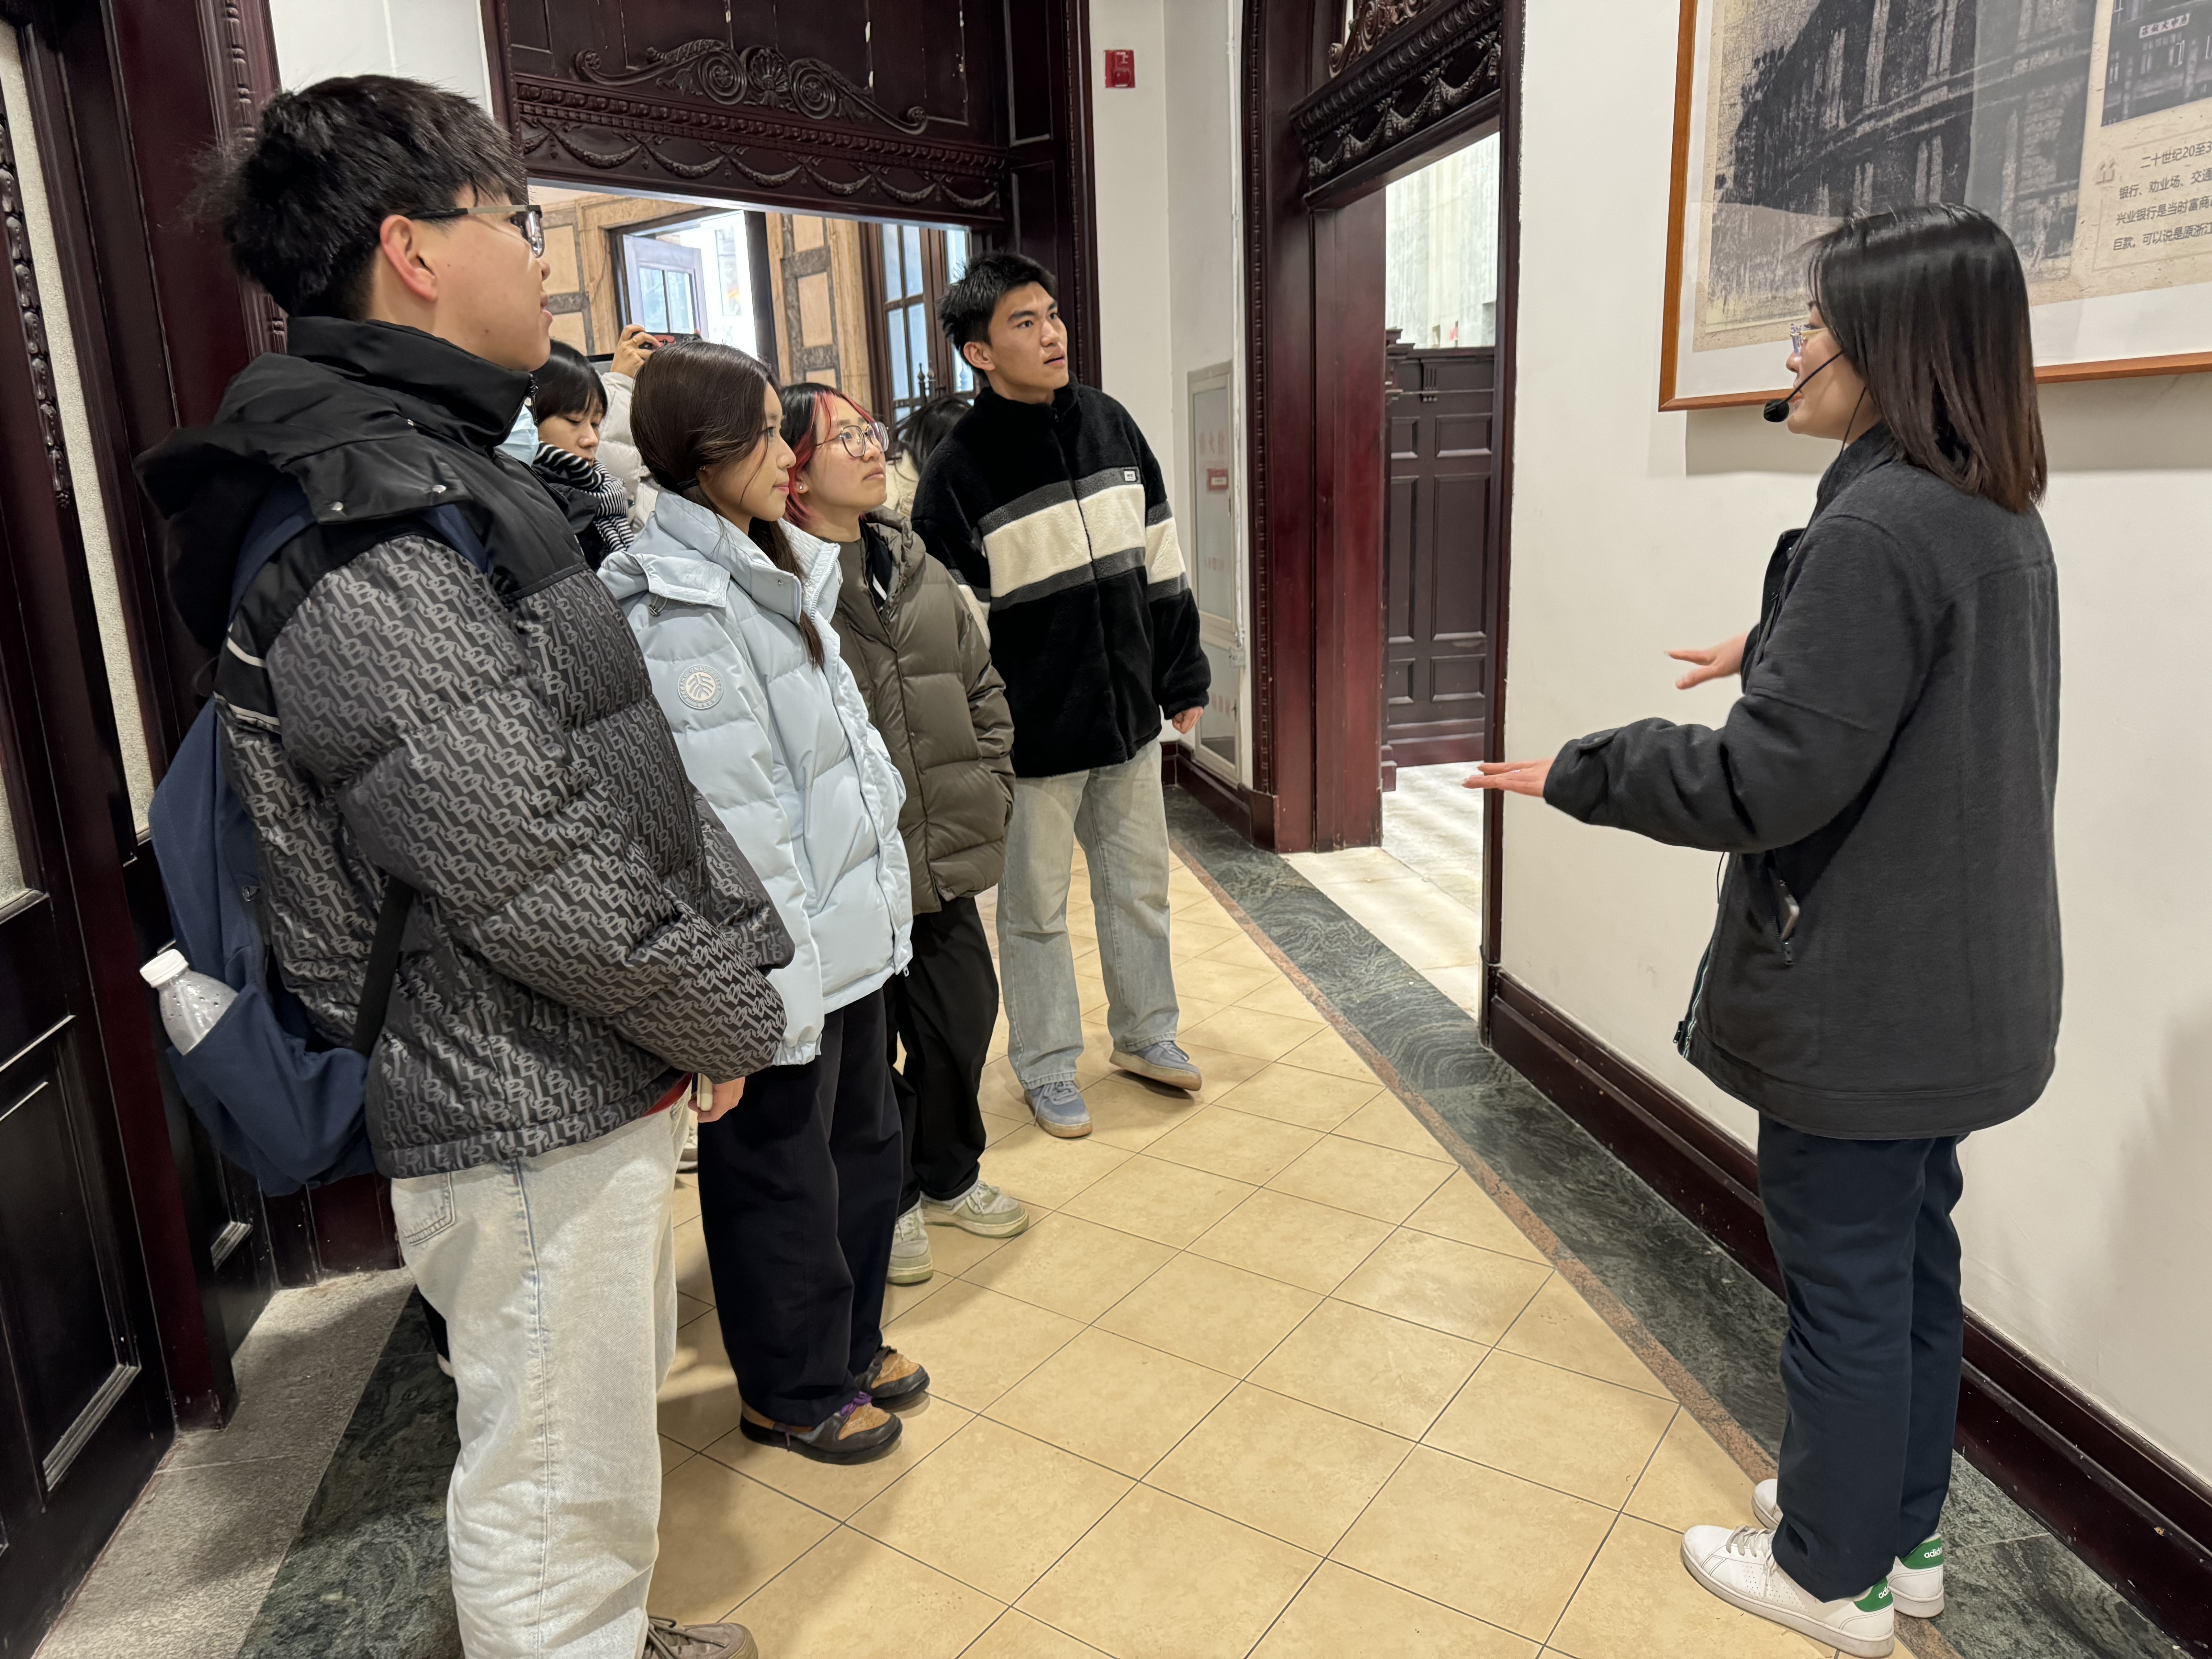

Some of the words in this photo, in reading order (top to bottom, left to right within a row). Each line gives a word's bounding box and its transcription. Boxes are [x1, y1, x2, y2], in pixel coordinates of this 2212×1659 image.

[2116, 195, 2212, 226] 兴业银行是当时富商
